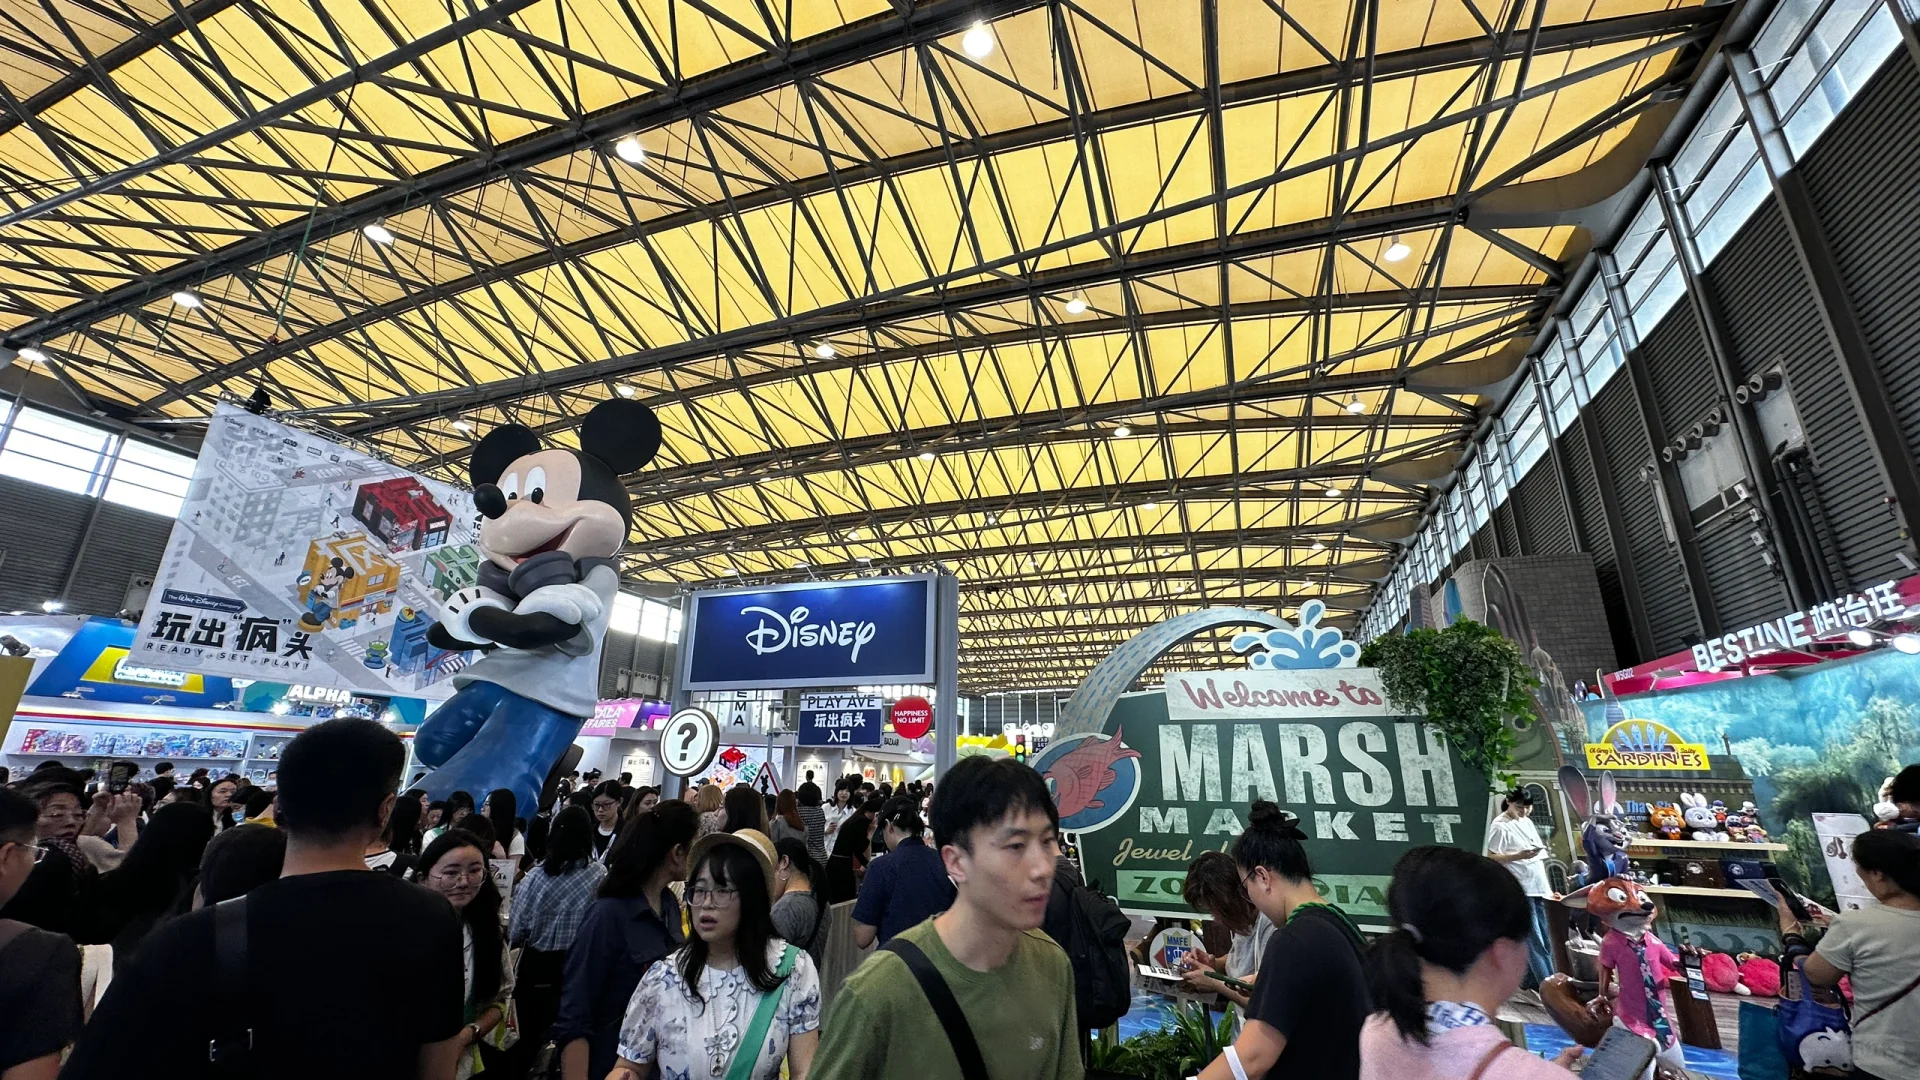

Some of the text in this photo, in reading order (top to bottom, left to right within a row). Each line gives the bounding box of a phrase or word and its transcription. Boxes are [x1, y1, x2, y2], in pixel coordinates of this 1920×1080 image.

[312, 466, 346, 480] READY
[227, 574, 251, 589] SET
[740, 606, 876, 664] Disney
[1692, 611, 1813, 672] BESTINE
[289, 684, 351, 703] ALPHA
[1180, 678, 1383, 709] Welcome to
[807, 694, 875, 709] PLAY AVE
[814, 712, 866, 728] 玩出疯头
[894, 710, 928, 718] HAPPINESS
[588, 719, 618, 729] FAIRIES
[827, 730, 851, 743] 入口
[1158, 721, 1459, 807] MARSH
[1595, 753, 1702, 767] SARDINES
[1625, 800, 1647, 813] Tha
[1139, 806, 1462, 843] MAKET
[1112, 837, 1192, 866] Jewel
[1167, 935, 1189, 946] MMFE
